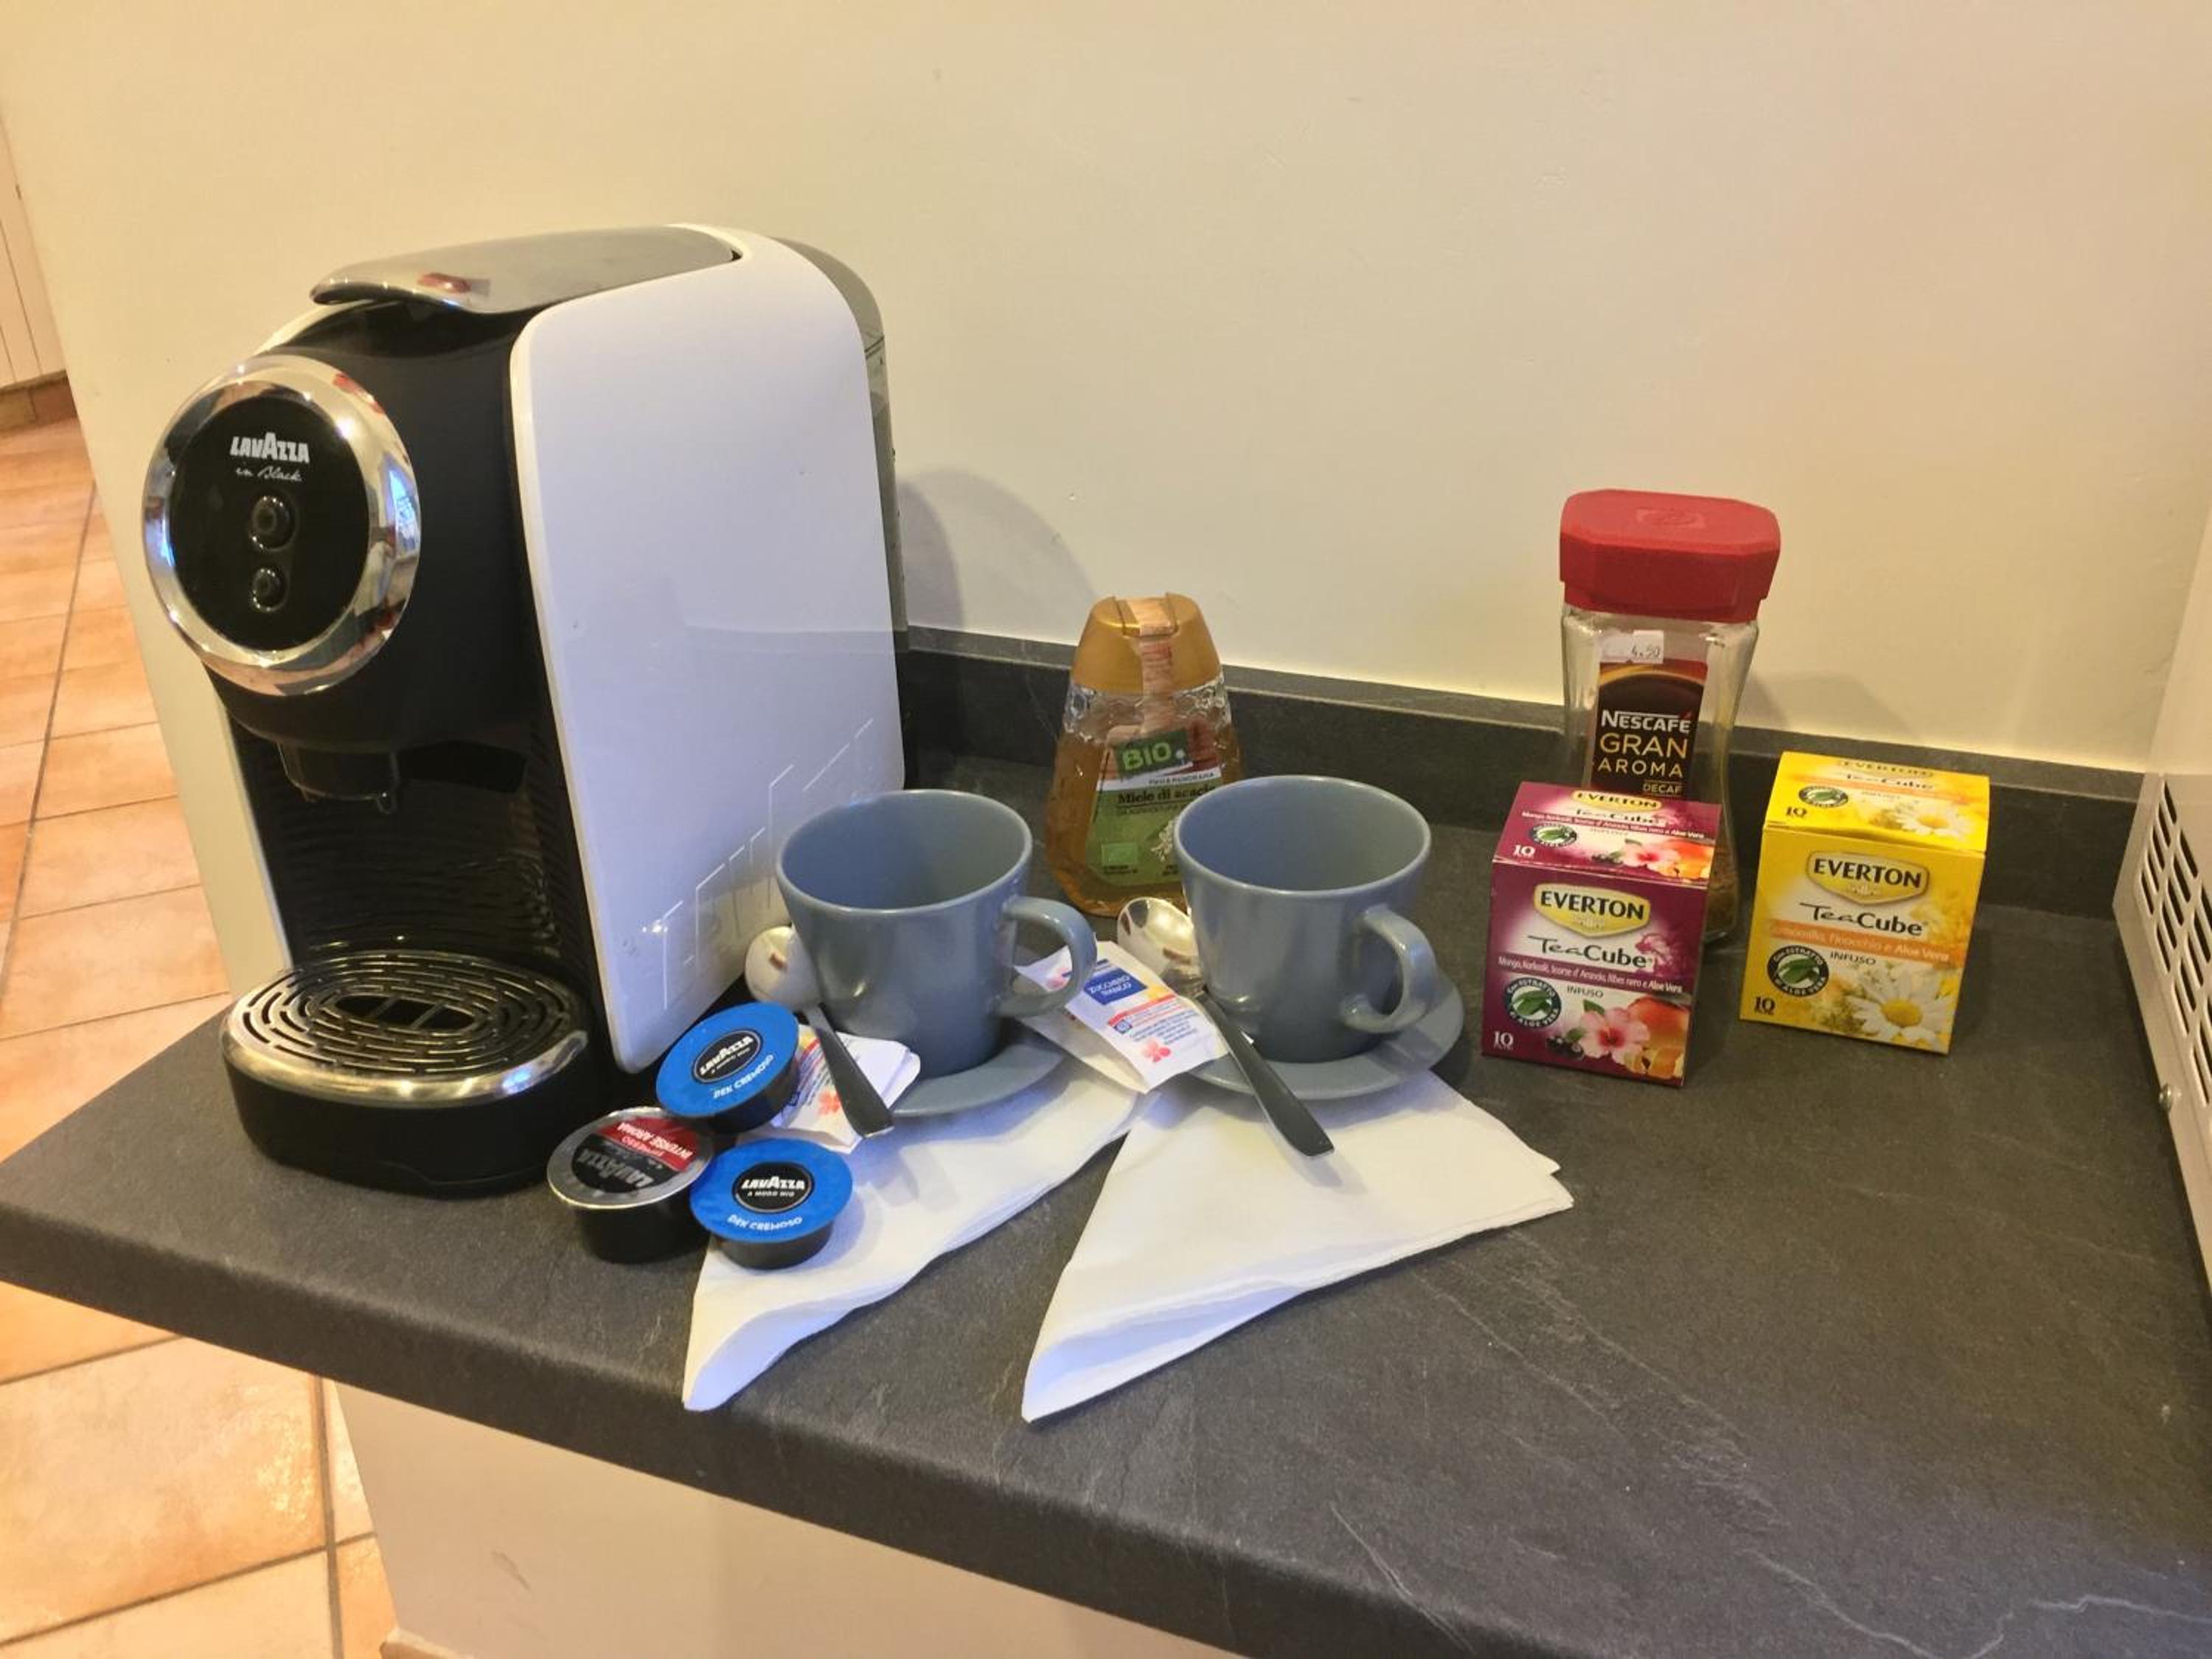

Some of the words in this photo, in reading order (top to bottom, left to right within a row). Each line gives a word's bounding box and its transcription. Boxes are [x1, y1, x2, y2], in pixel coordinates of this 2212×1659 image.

[229, 432, 310, 463] LAVAZZA
[1599, 732, 1688, 759] GRAN
[1123, 742, 1172, 771] BIO
[1598, 757, 1683, 778] AROMA
[1119, 791, 1155, 804] Miele
[1643, 783, 1682, 795] DECAF
[1786, 807, 1807, 818] 10
[1513, 844, 1536, 856] 10
[1814, 858, 1922, 888] EVERTON
[1540, 891, 1645, 920] EVERTON
[1830, 951, 1877, 966] INFUSO
[1894, 944, 1919, 956] Aloe
[1921, 947, 1950, 961] Vera
[1567, 984, 1604, 998] INFUSO
[1648, 978, 1665, 990] Aloe
[1665, 982, 1683, 993] Vera
[1754, 996, 1775, 1012] 10
[1494, 1031, 1514, 1046] 10
[700, 1036, 754, 1075] LAVAZZA
[734, 1054, 773, 1089] CREMOSO
[577, 1148, 655, 1188] LAVAZZA
[741, 1175, 805, 1190] LAVAZZA
[727, 1214, 750, 1228] DEK
[749, 1216, 803, 1231] CREMOSO
